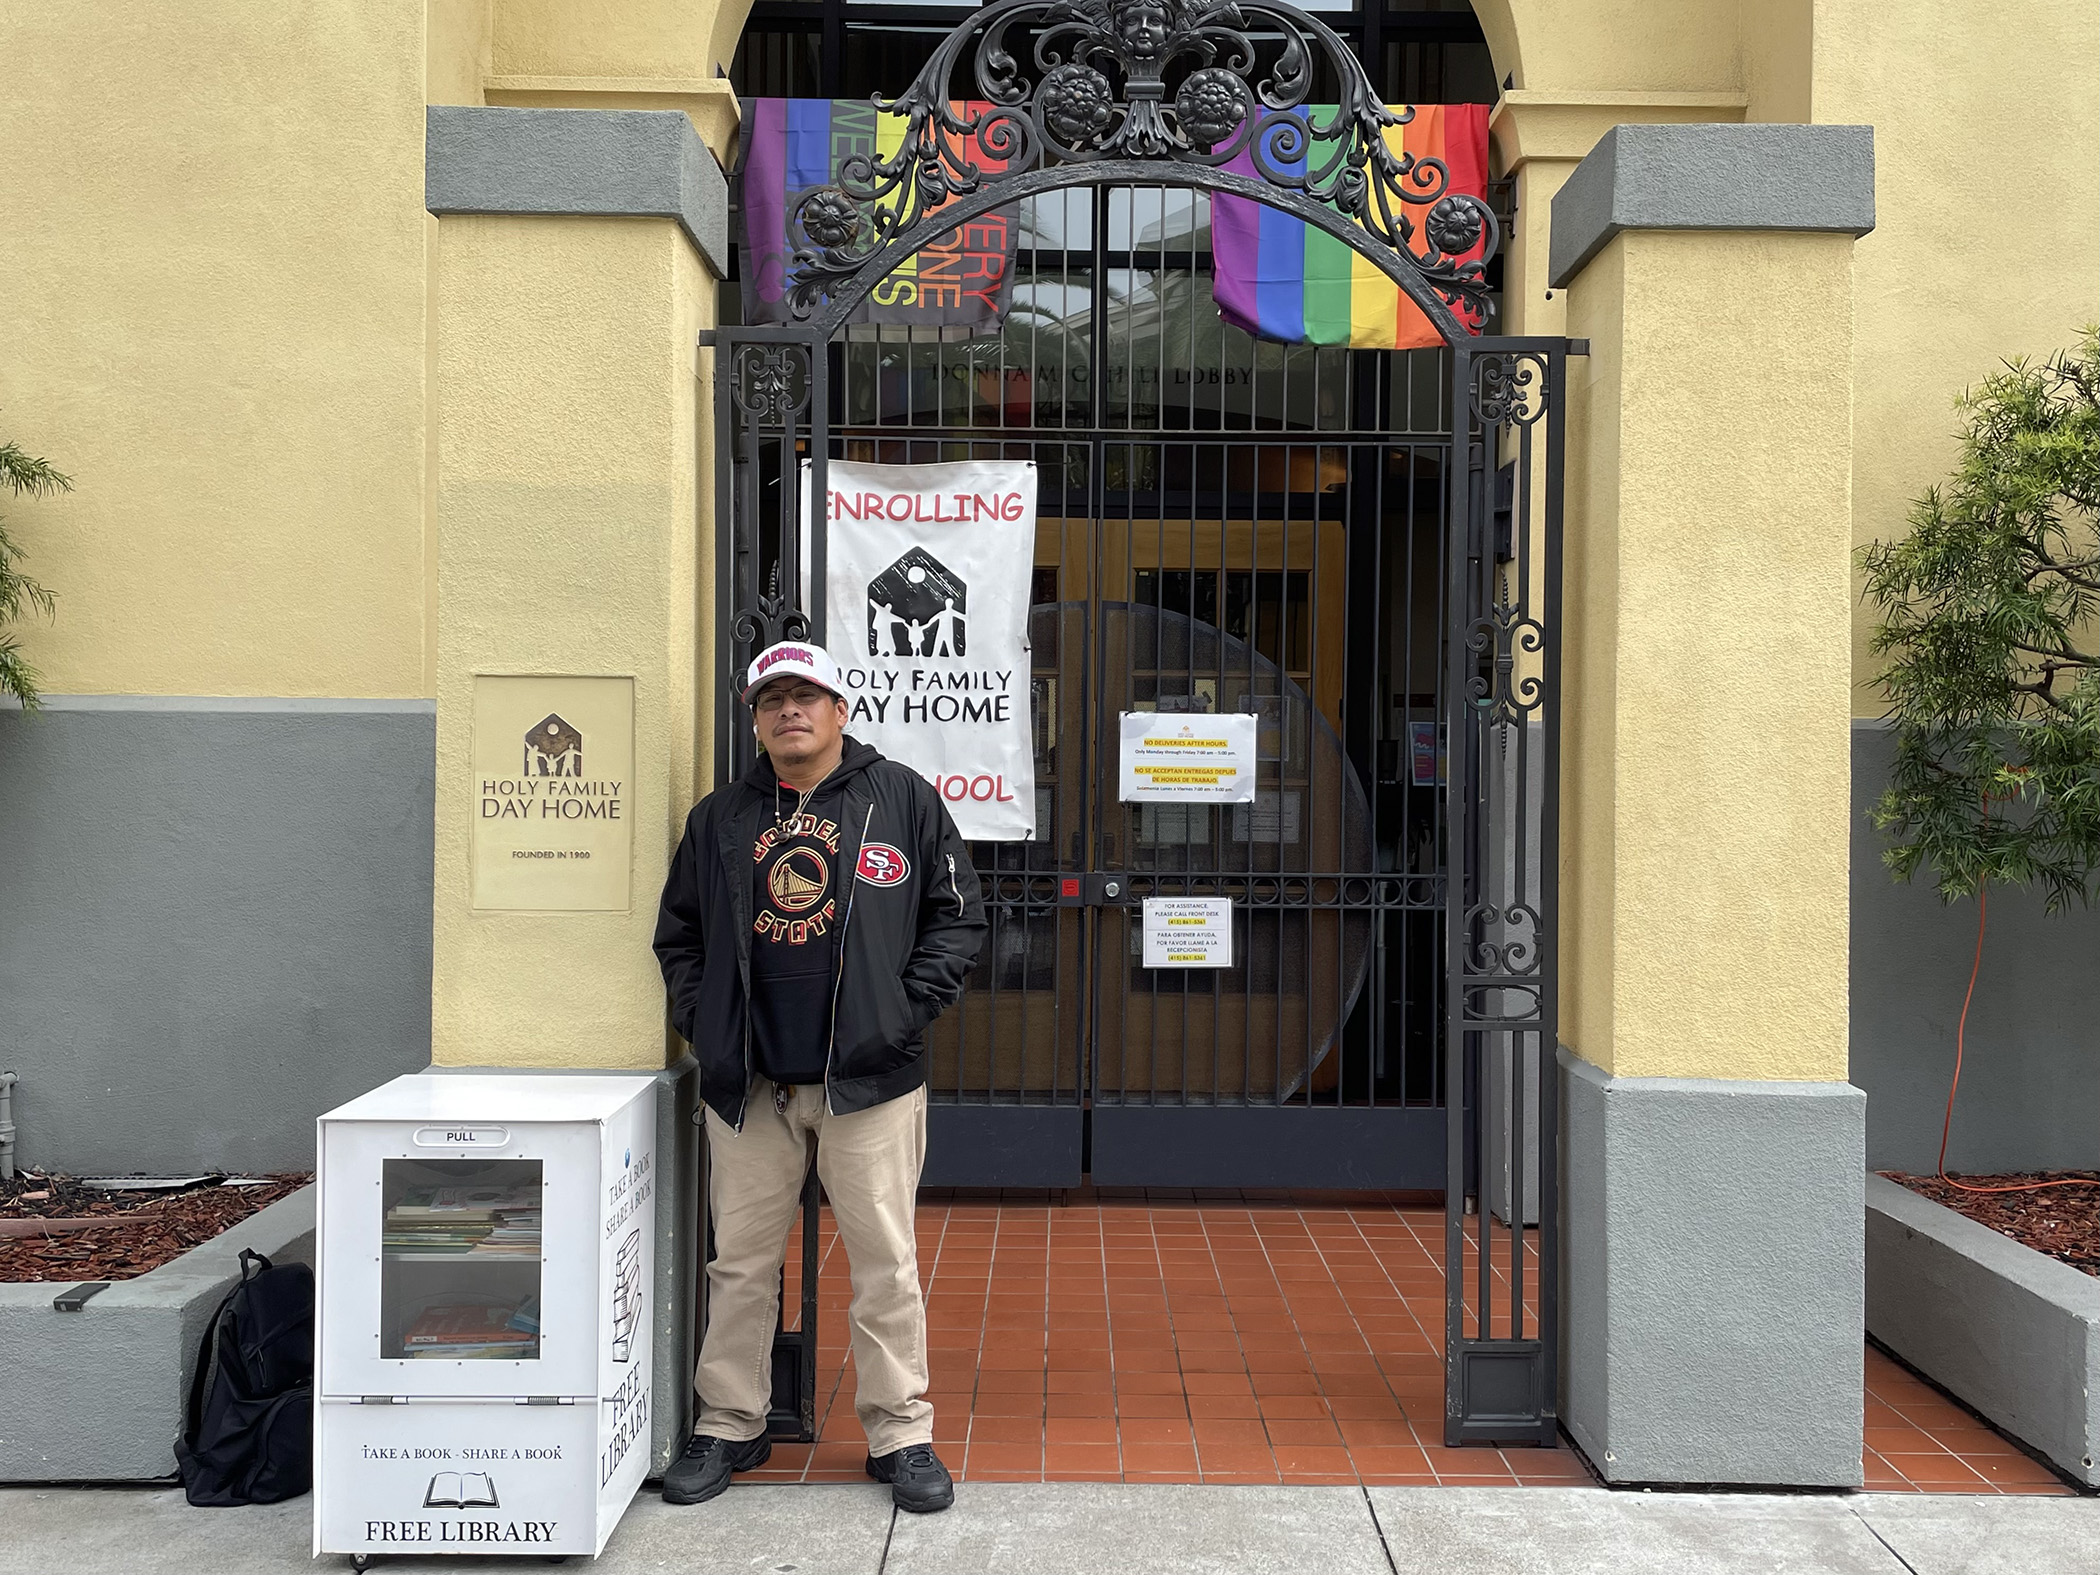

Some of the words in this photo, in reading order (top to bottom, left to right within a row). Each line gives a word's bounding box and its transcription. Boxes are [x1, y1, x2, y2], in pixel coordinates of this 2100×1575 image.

[932, 363, 1029, 383] DONNA
[1174, 366, 1253, 385] LOBBY
[826, 491, 1025, 522] NROLLING
[756, 646, 814, 676] WARRIORS
[837, 667, 899, 691] OLY
[911, 669, 1012, 692] FAMILY
[849, 694, 892, 724] AY
[903, 694, 1012, 724] HOME
[482, 780, 539, 795] HOLY
[548, 781, 622, 796] FAMILY
[481, 798, 534, 819] DAY
[542, 799, 620, 819] HOME
[512, 850, 554, 859] FOUNDED
[557, 850, 567, 859] IN
[569, 851, 590, 860] 1900
[865, 849, 900, 881] SF
[446, 1131, 476, 1143] PULL
[609, 1174, 627, 1206] TAKE
[628, 1170, 633, 1188] A
[633, 1152, 650, 1182] BOOK
[606, 1202, 628, 1240] SHARE
[629, 1196, 634, 1214] A
[635, 1178, 652, 1210] BOOK
[612, 1360, 641, 1430] FREE
[601, 1386, 650, 1490] LIBRARY
[361, 1448, 397, 1459] TAKE
[401, 1448, 410, 1459] A
[414, 1448, 452, 1459] BOOK
[462, 1448, 508, 1460] SHARE
[512, 1448, 521, 1460] A
[525, 1448, 562, 1460] BOOK
[365, 1521, 432, 1542] FREE
[440, 1521, 558, 1542] LIBRARY
